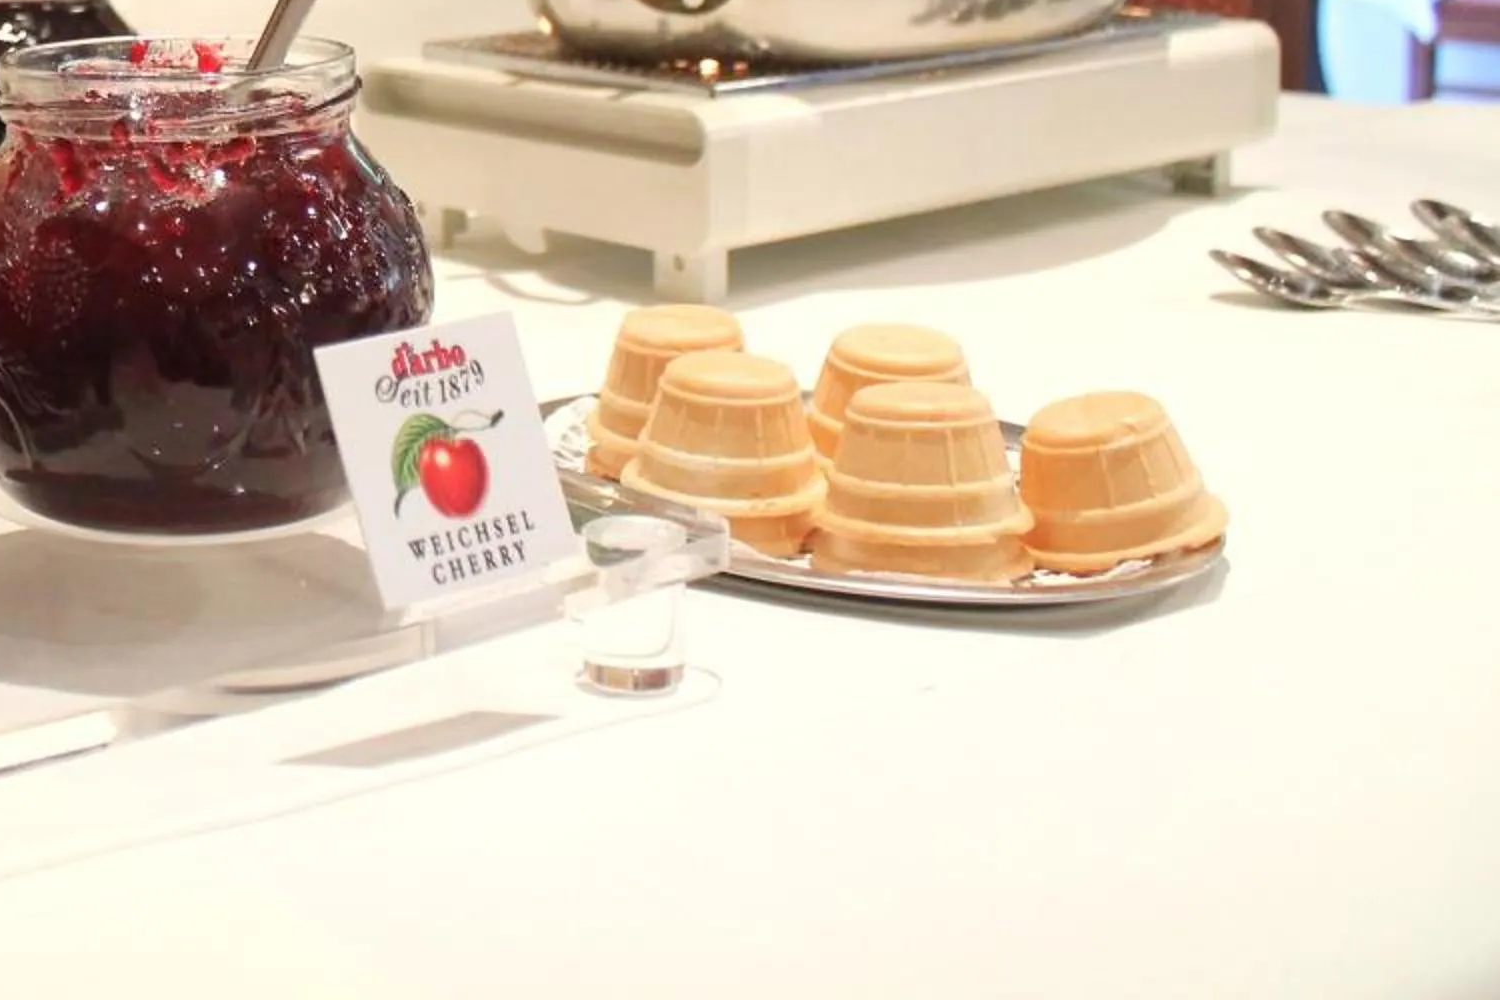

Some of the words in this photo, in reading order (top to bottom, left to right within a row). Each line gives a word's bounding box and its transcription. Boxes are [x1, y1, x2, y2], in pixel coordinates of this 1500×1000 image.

[375, 374, 433, 408] Seit
[439, 359, 485, 403] 1879
[407, 510, 535, 560] WEICHSEL
[431, 539, 526, 585] CHERRY
